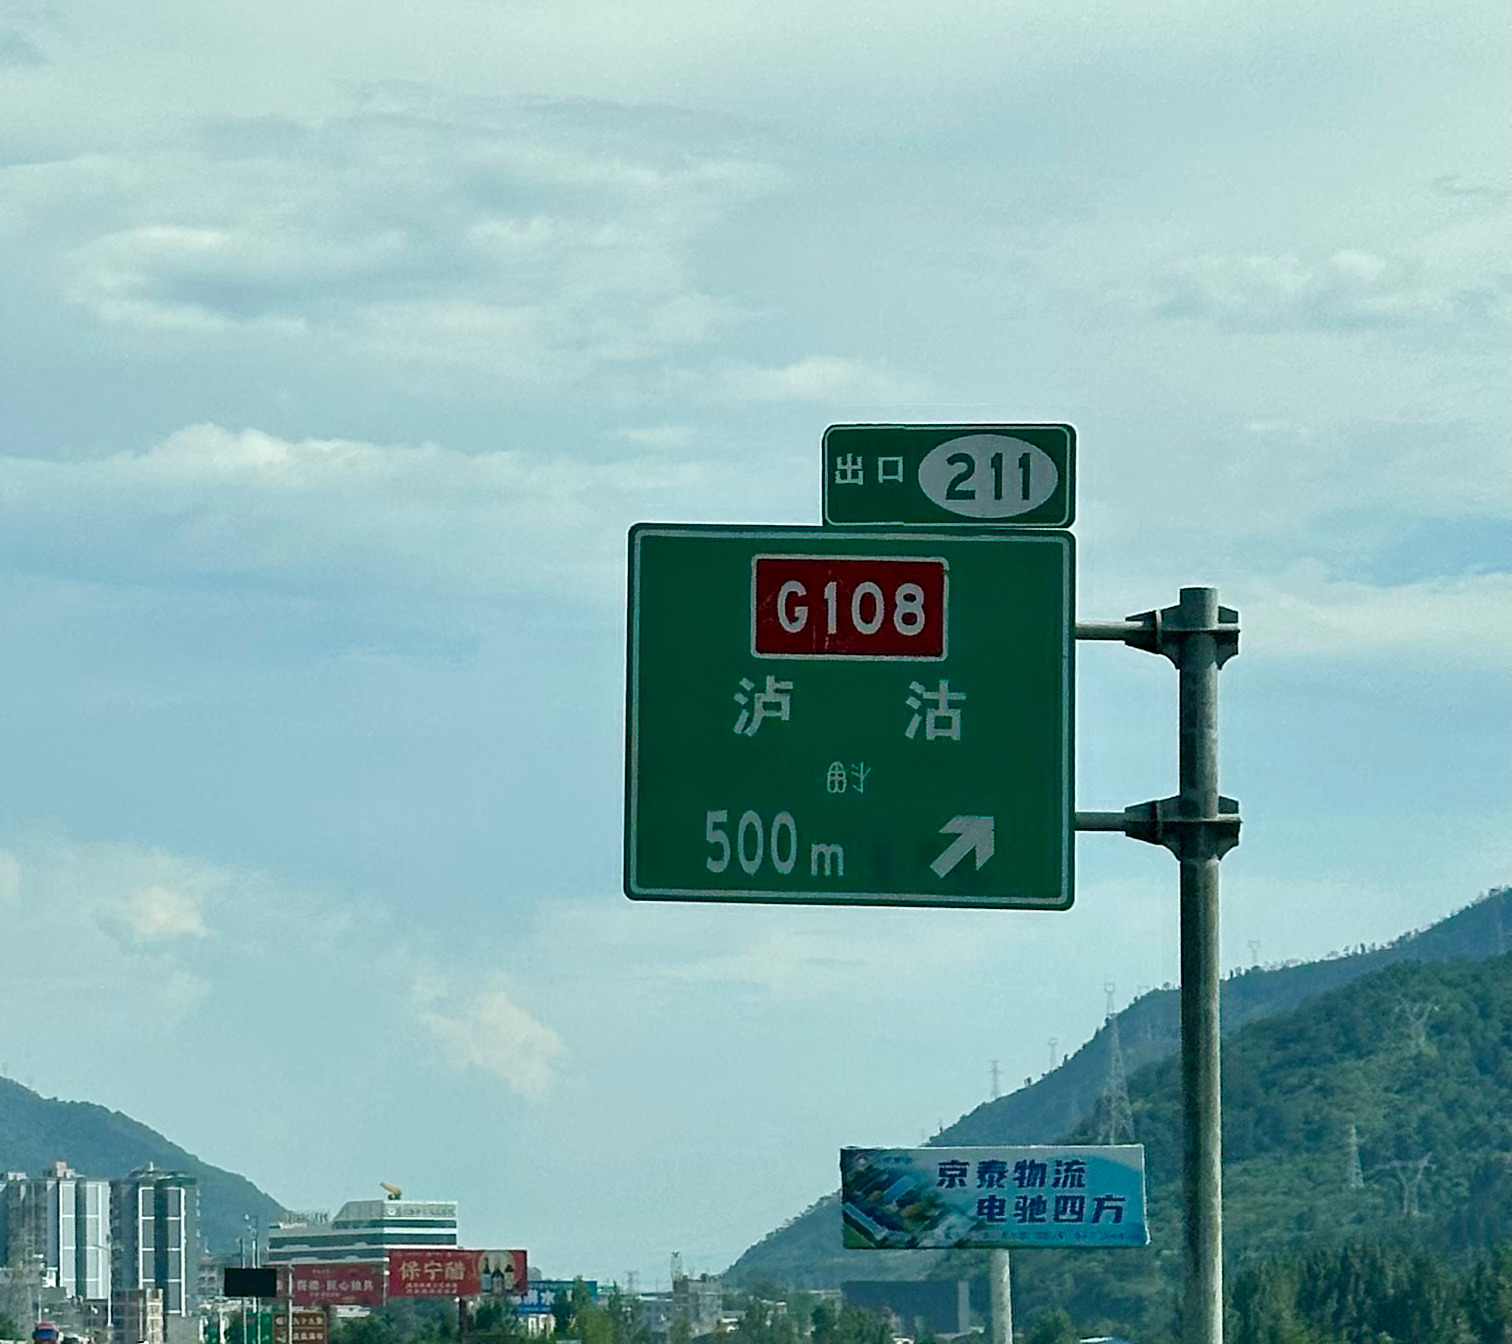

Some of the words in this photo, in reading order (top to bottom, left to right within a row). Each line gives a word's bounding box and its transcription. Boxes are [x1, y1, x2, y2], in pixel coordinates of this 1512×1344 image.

[836, 454, 904, 485] 出口
[945, 454, 1034, 501] 211
[777, 582, 925, 636] G108
[733, 676, 966, 740] 泸沽
[705, 810, 798, 874] 500
[811, 843, 844, 876] m
[938, 1160, 1086, 1189] 京泰物流
[977, 1195, 1126, 1225] 电驰四方
